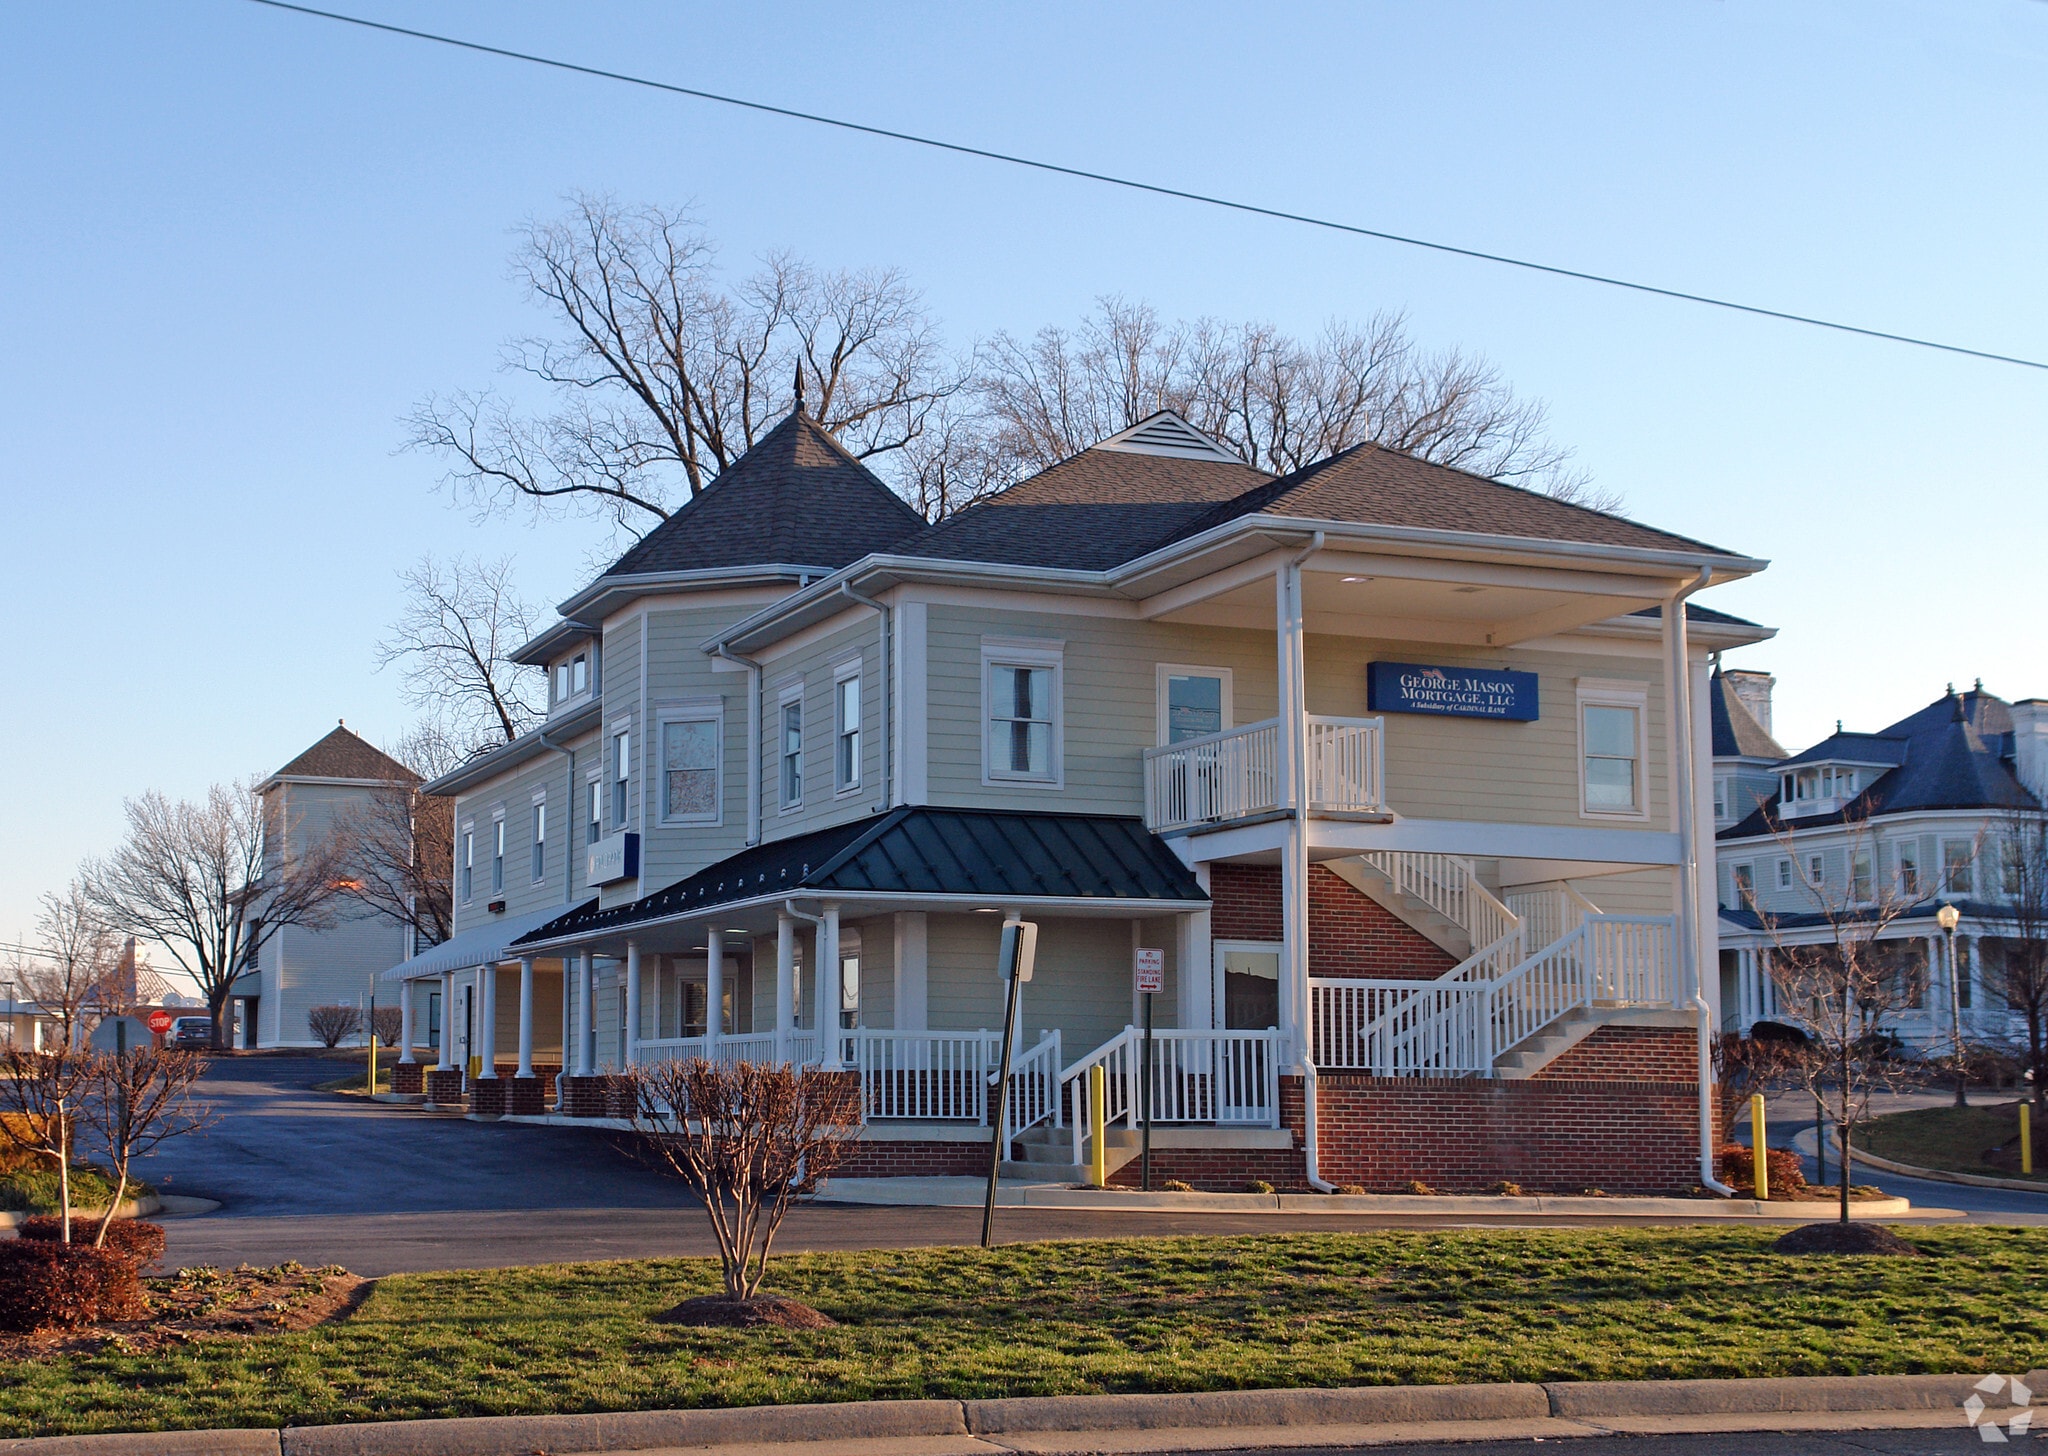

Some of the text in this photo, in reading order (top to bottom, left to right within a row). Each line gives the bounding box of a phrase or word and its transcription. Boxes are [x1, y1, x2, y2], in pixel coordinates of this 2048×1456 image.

[1400, 674, 1514, 694] GEORGE MASON
[1489, 695, 1515, 706] LLC
[1447, 704, 1453, 712] of
[150, 1017, 170, 1028] STOP
